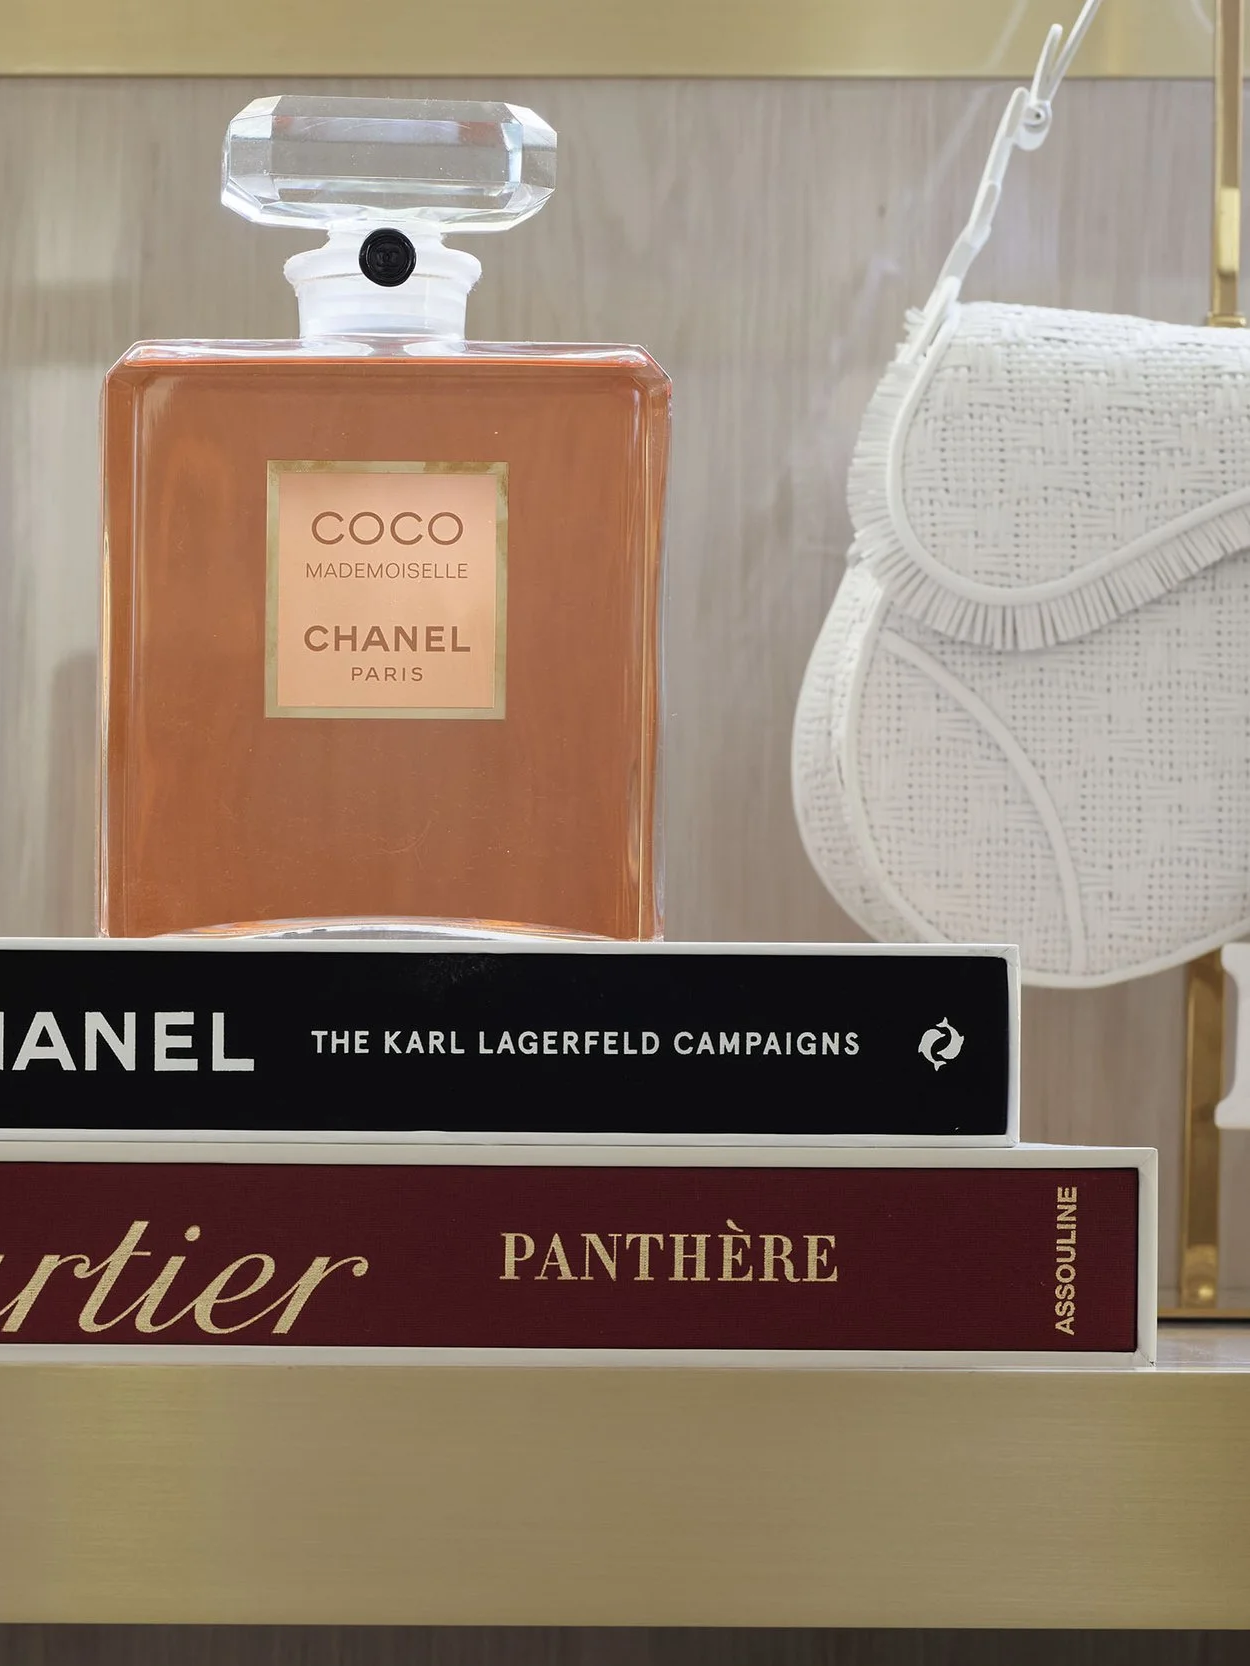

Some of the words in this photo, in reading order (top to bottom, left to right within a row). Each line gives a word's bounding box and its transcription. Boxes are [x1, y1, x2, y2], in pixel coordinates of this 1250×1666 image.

[311, 511, 464, 546] COCO
[305, 562, 468, 579] MADEMOISELLE
[303, 625, 471, 653] CHANEL
[351, 666, 424, 682] PARIS
[310, 1030, 370, 1055] THE
[384, 1030, 465, 1055] KARL
[479, 1030, 661, 1056] LAGERFELD
[673, 1031, 861, 1056] CAMPAIGNS
[499, 1218, 839, 1283] PANTHÈRE
[1054, 1184, 1079, 1336] ASSOULINE
